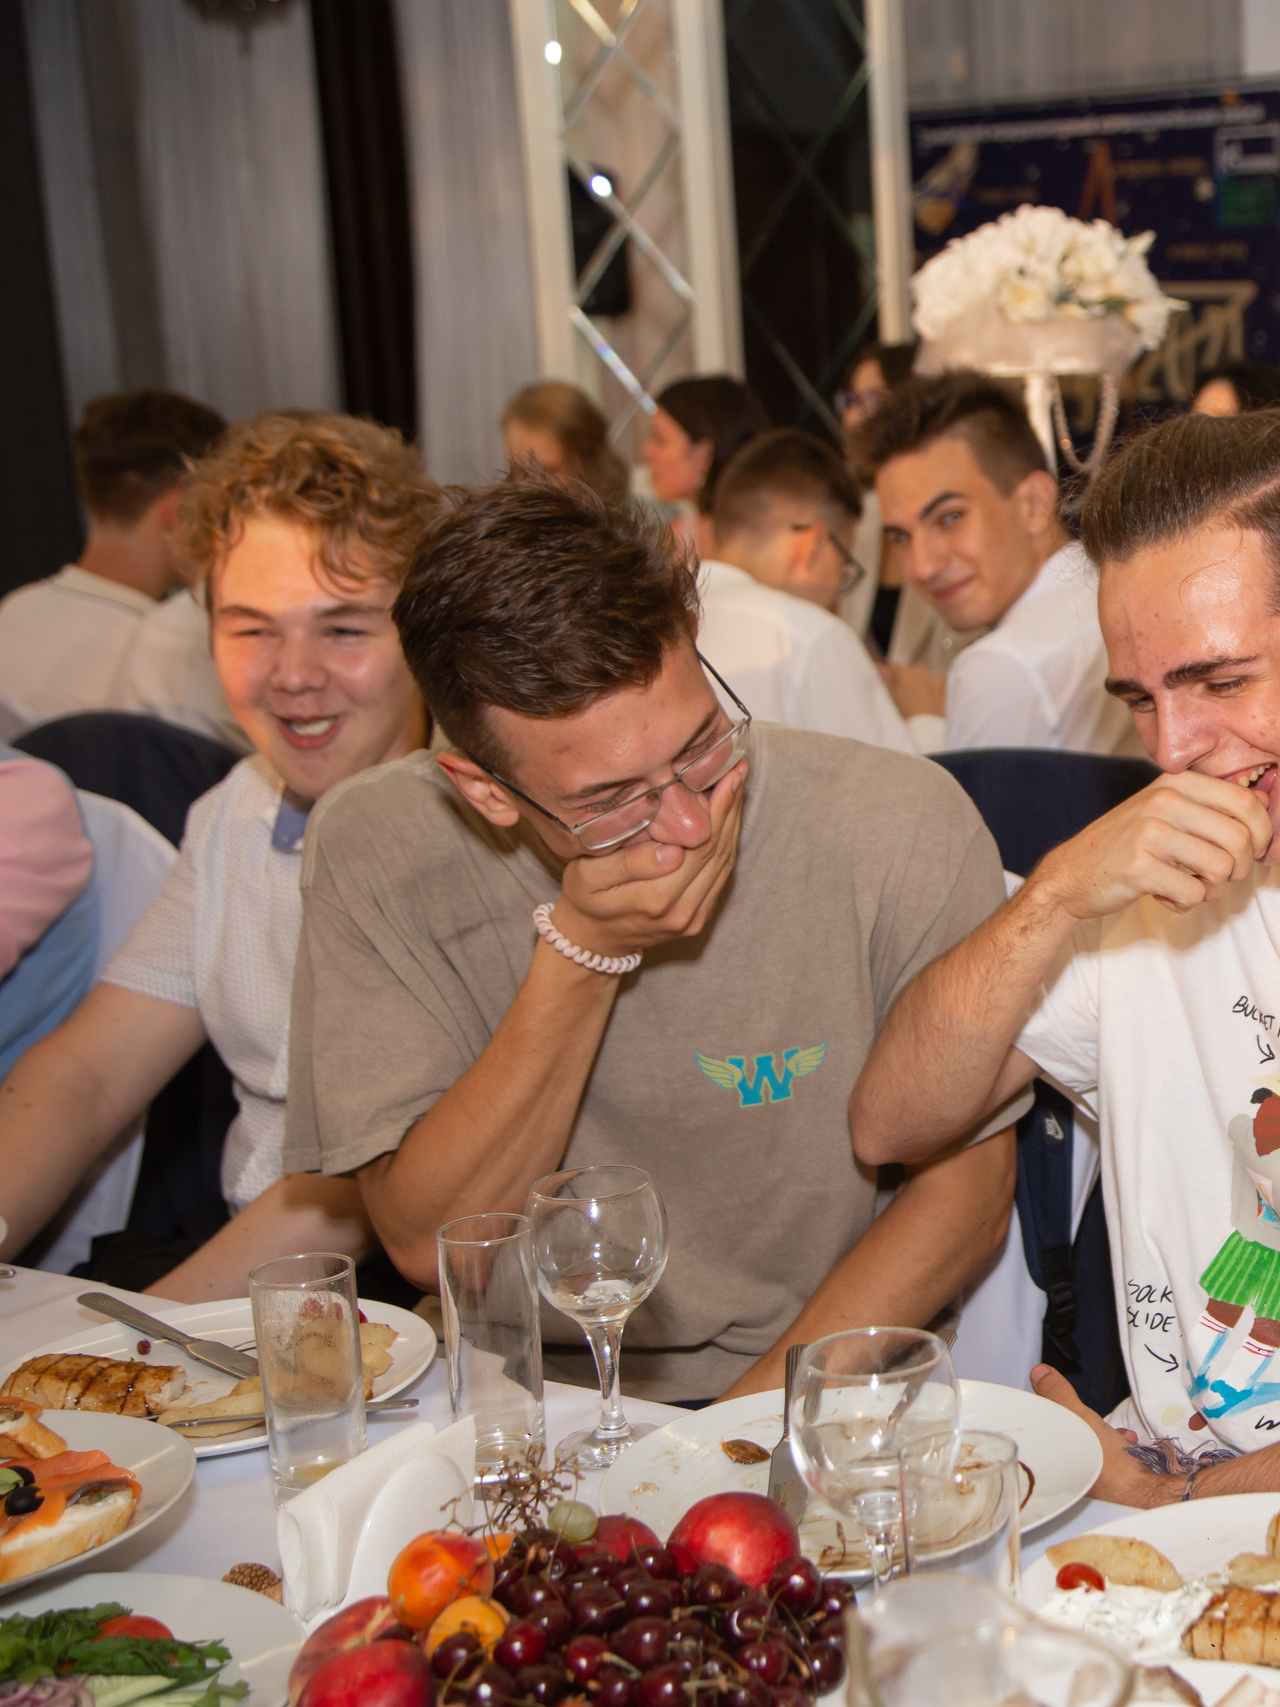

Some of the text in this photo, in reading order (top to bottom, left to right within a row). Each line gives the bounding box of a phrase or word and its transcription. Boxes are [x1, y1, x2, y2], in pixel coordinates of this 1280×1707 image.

[1232, 995, 1276, 1031] BUCKET
[725, 1046, 802, 1108] W
[1127, 1278, 1173, 1303] SOCK
[1126, 1306, 1176, 1333] SLIDE
